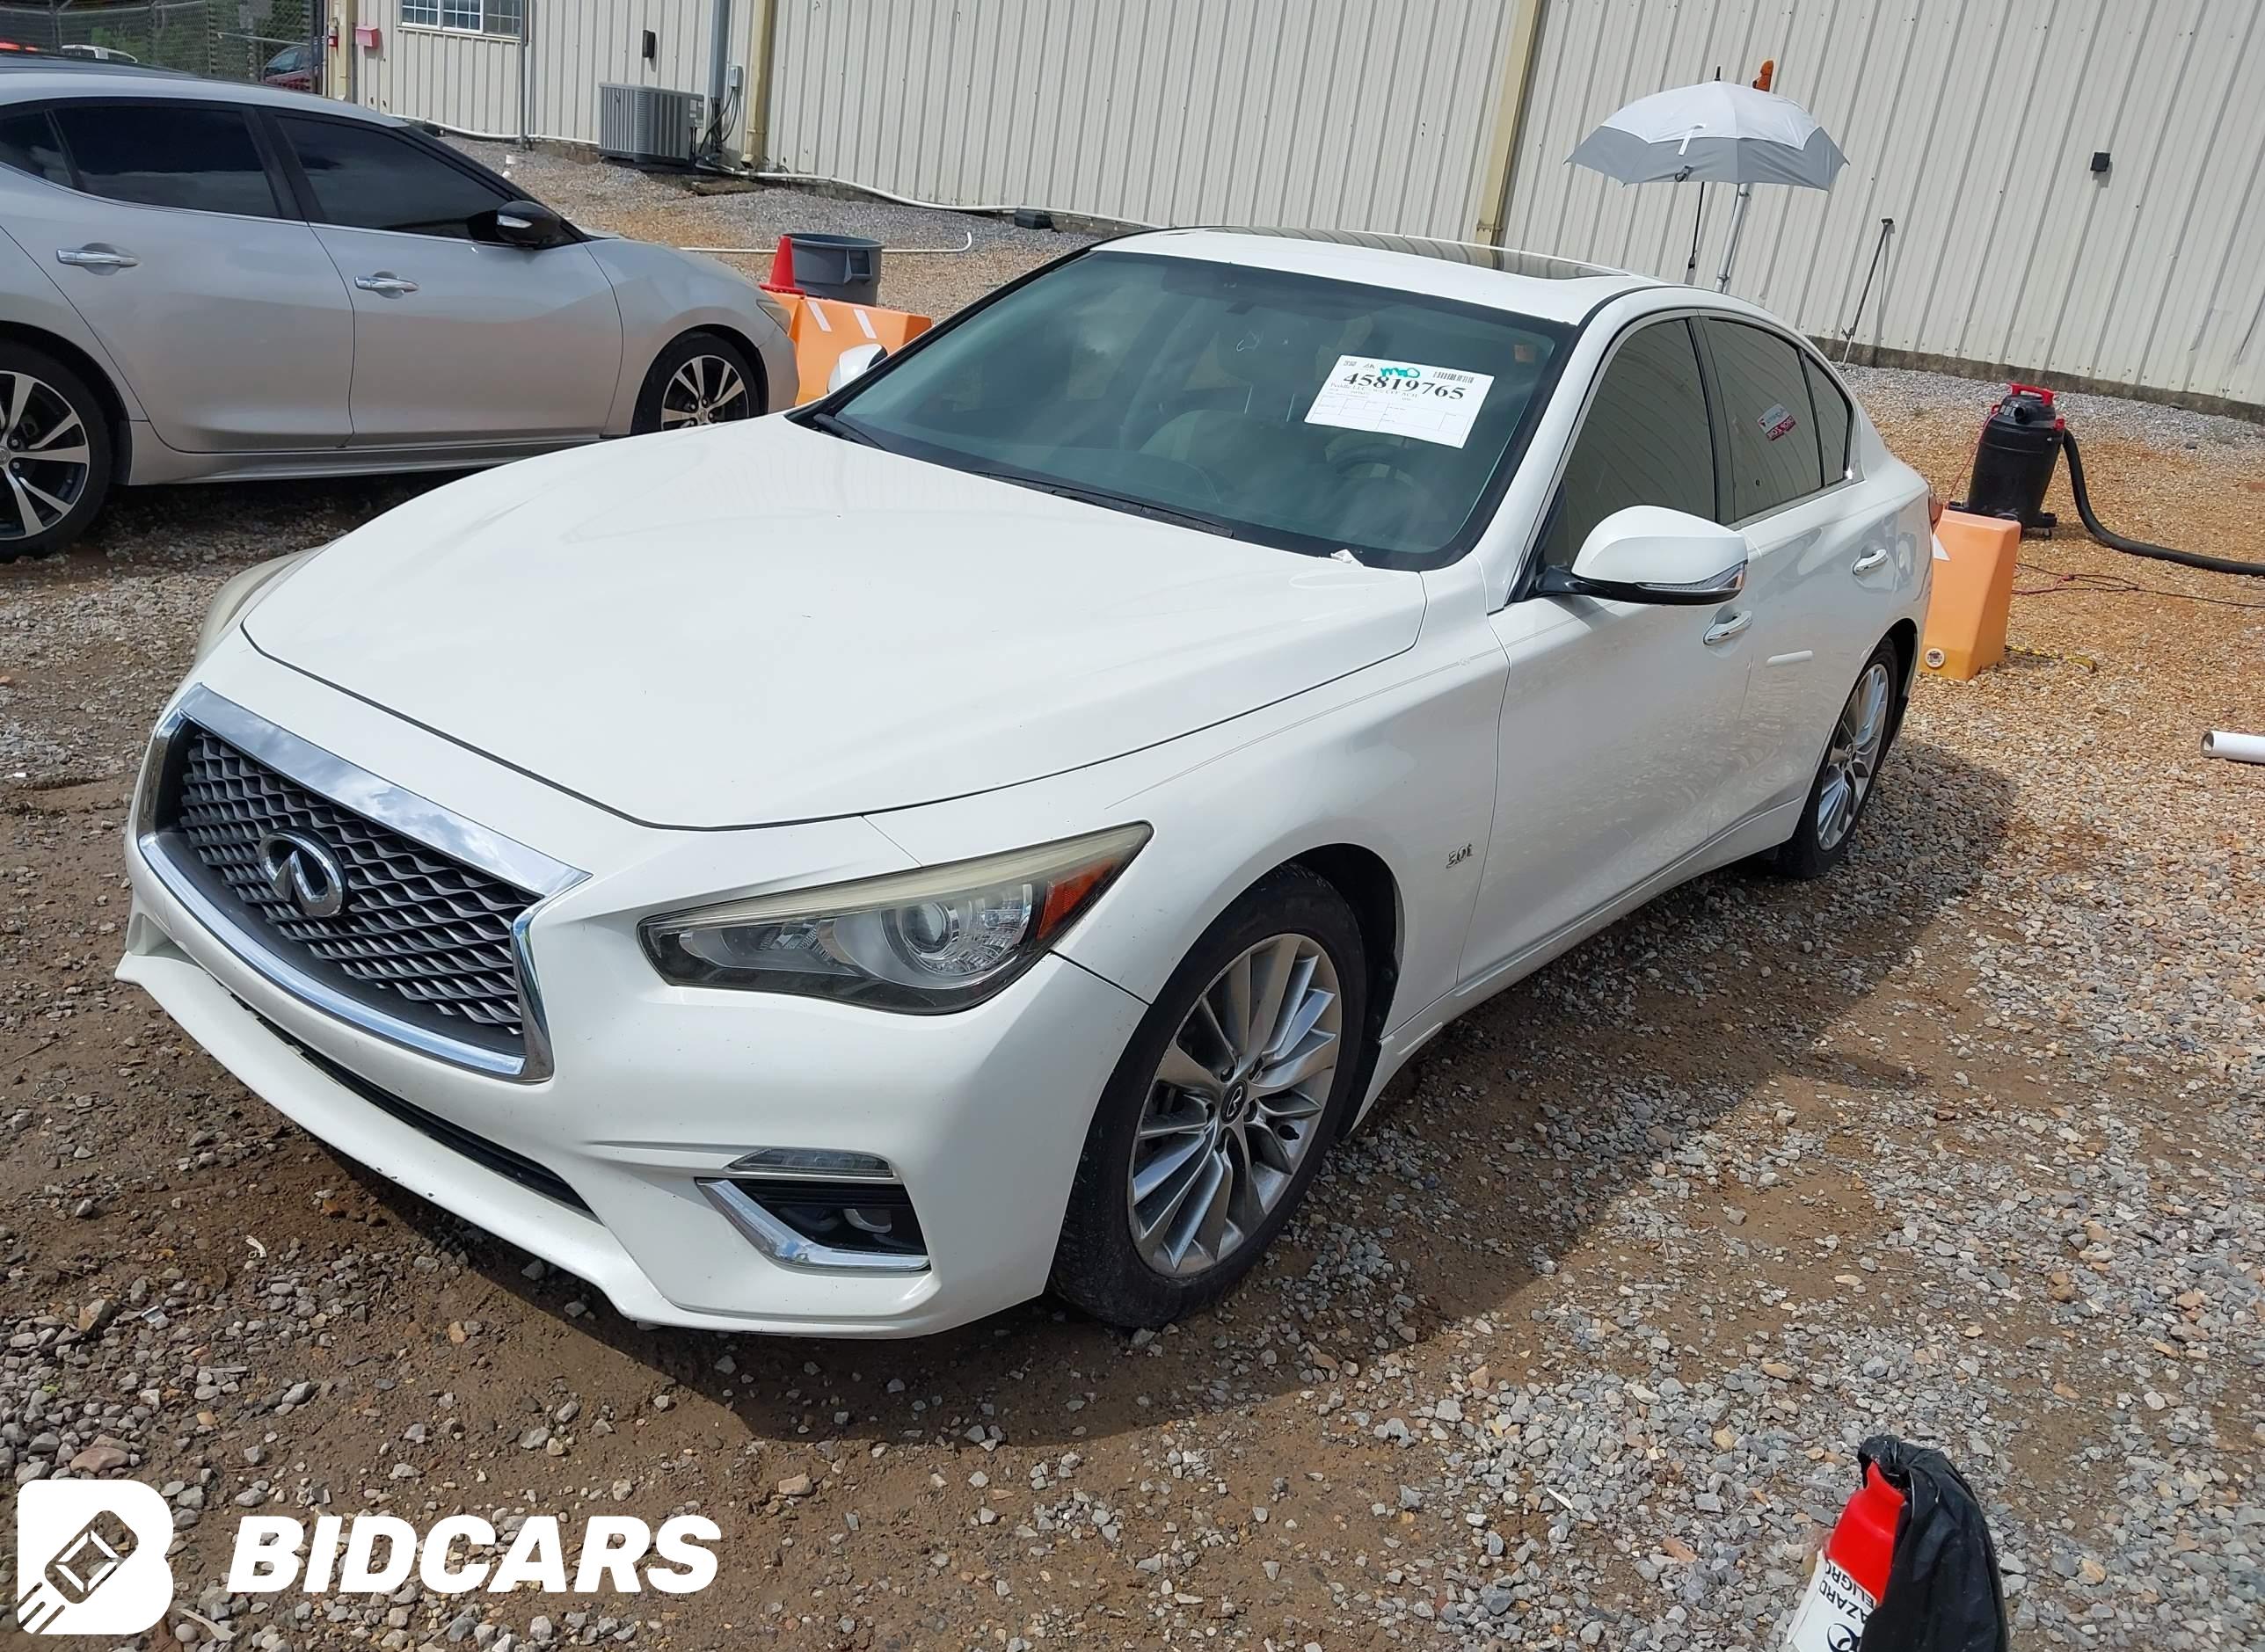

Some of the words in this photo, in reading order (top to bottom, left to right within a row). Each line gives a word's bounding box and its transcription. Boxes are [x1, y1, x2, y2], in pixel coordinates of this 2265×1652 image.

[1344, 373, 1468, 400] 45819765
[1819, 1579, 1869, 1625] AZARD
[1824, 1561, 1875, 1610] ELIGRO
